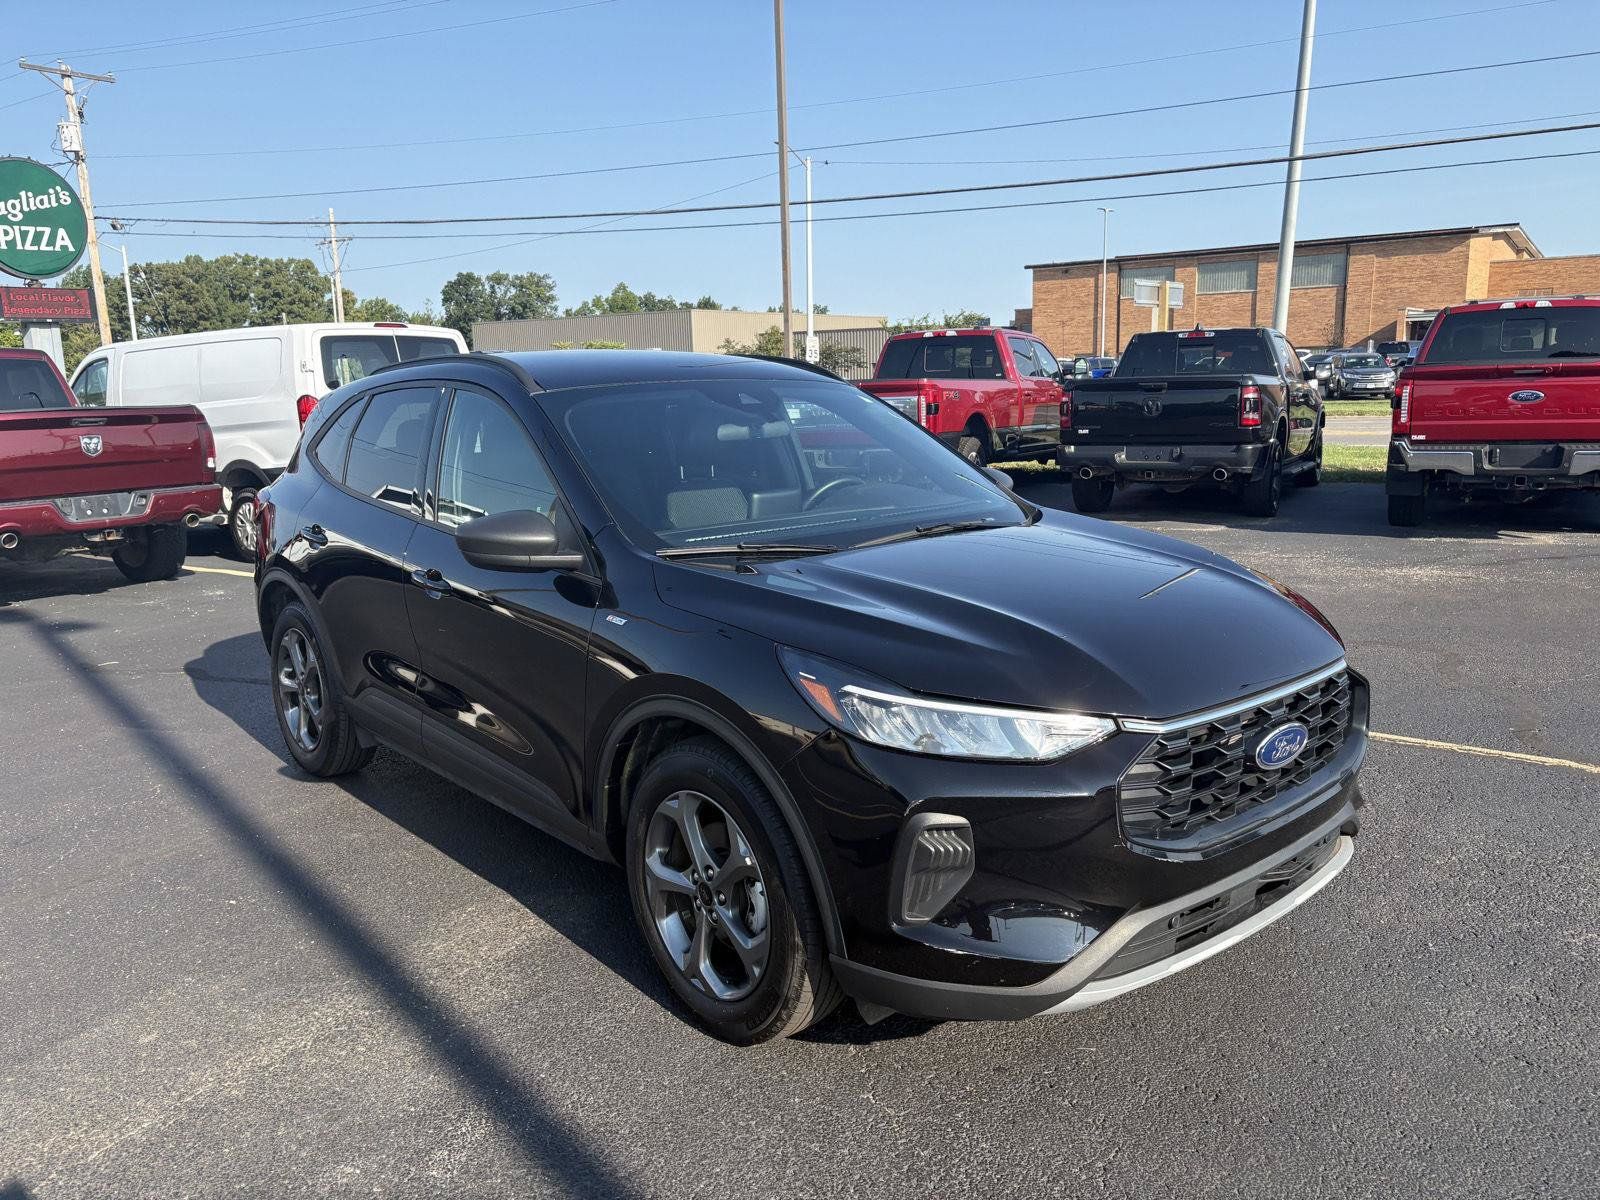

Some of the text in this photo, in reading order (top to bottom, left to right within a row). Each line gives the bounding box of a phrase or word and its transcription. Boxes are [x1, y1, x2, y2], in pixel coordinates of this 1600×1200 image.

[0, 225, 75, 252] PIZZA
[10, 293, 80, 303] Local Flavor,
[4, 306, 61, 315] Legendary
[943, 391, 960, 400] FX4
[1424, 407, 1533, 417] SUPER
